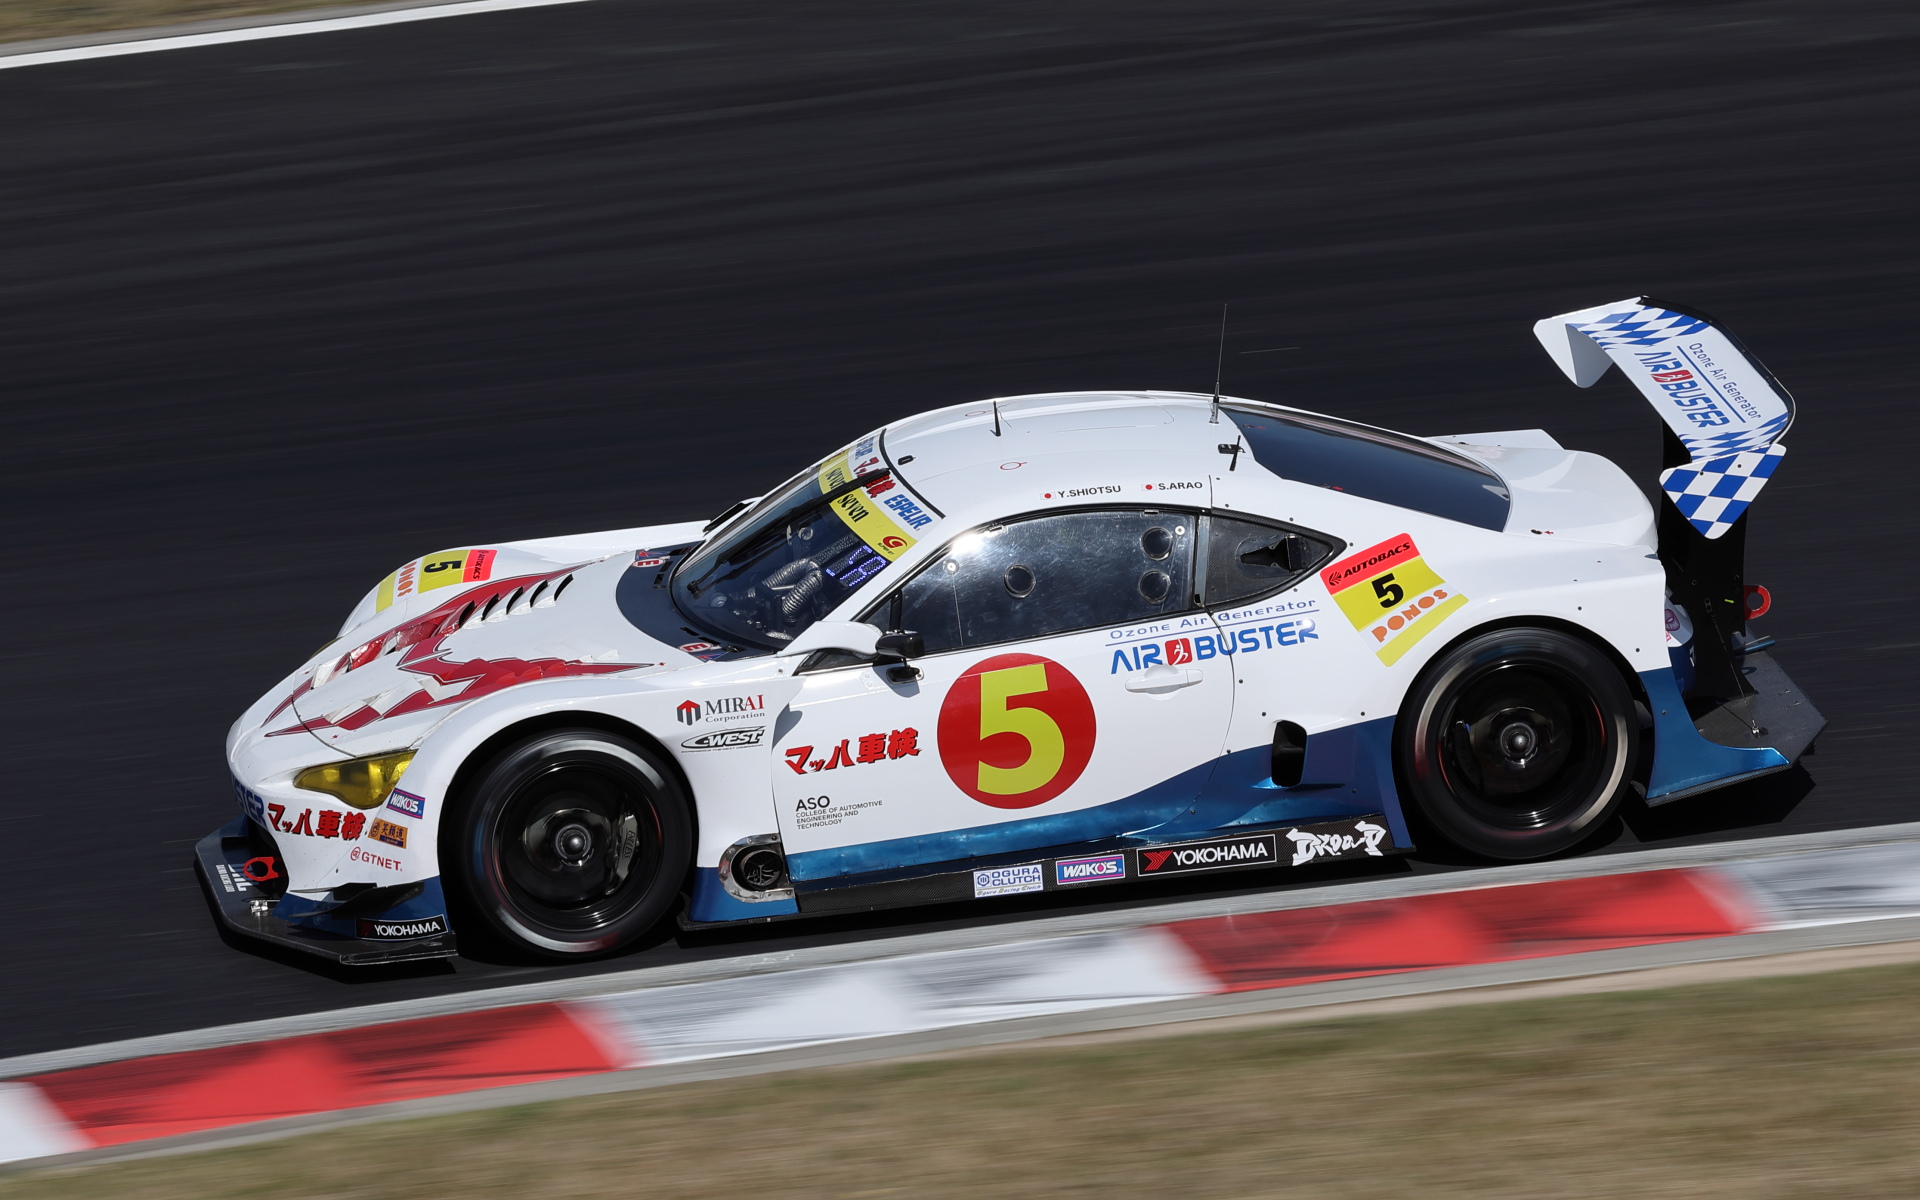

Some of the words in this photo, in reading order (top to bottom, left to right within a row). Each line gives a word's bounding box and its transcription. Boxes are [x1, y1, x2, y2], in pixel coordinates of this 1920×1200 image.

[1634, 351, 1683, 372] AIR
[1660, 380, 1730, 428] BUSTER
[1689, 343, 1715, 368] Ozone
[1709, 368, 1727, 380] Air
[1723, 381, 1762, 419] Generator
[1058, 485, 1122, 498] Y.SHIOTSU
[1158, 481, 1203, 490] S.ARAO
[837, 493, 869, 523] seven
[884, 494, 933, 530] ESPELIR
[424, 560, 462, 573] 5
[1343, 542, 1411, 579] AUTOBACS
[397, 561, 417, 597] PONOS
[1371, 573, 1404, 608] 5
[1110, 623, 1171, 639] Ozone
[1180, 616, 1208, 629] Air
[1218, 599, 1316, 622] Generator
[1371, 589, 1448, 643] PONOS
[1111, 643, 1163, 674] AIR
[1195, 619, 1319, 661] BUSTER
[704, 694, 765, 716] MIRAI
[705, 711, 766, 723] Corporation
[977, 663, 1065, 795] 5
[784, 727, 923, 775] マッハ車検
[795, 795, 831, 812] ASO
[796, 808, 827, 818] COLLEGE
[839, 800, 883, 811] AUTOMOTIVE
[796, 813, 843, 824] ENGINEERING
[844, 809, 859, 817] AND
[267, 802, 367, 841] マッハ車検
[797, 818, 843, 830] TECHNOLOGY
[1173, 842, 1268, 866] YOKOHAMA
[991, 867, 1040, 878] OGURA
[992, 875, 1041, 886] CLUTCH
[374, 921, 441, 937] YOKOHAMA
